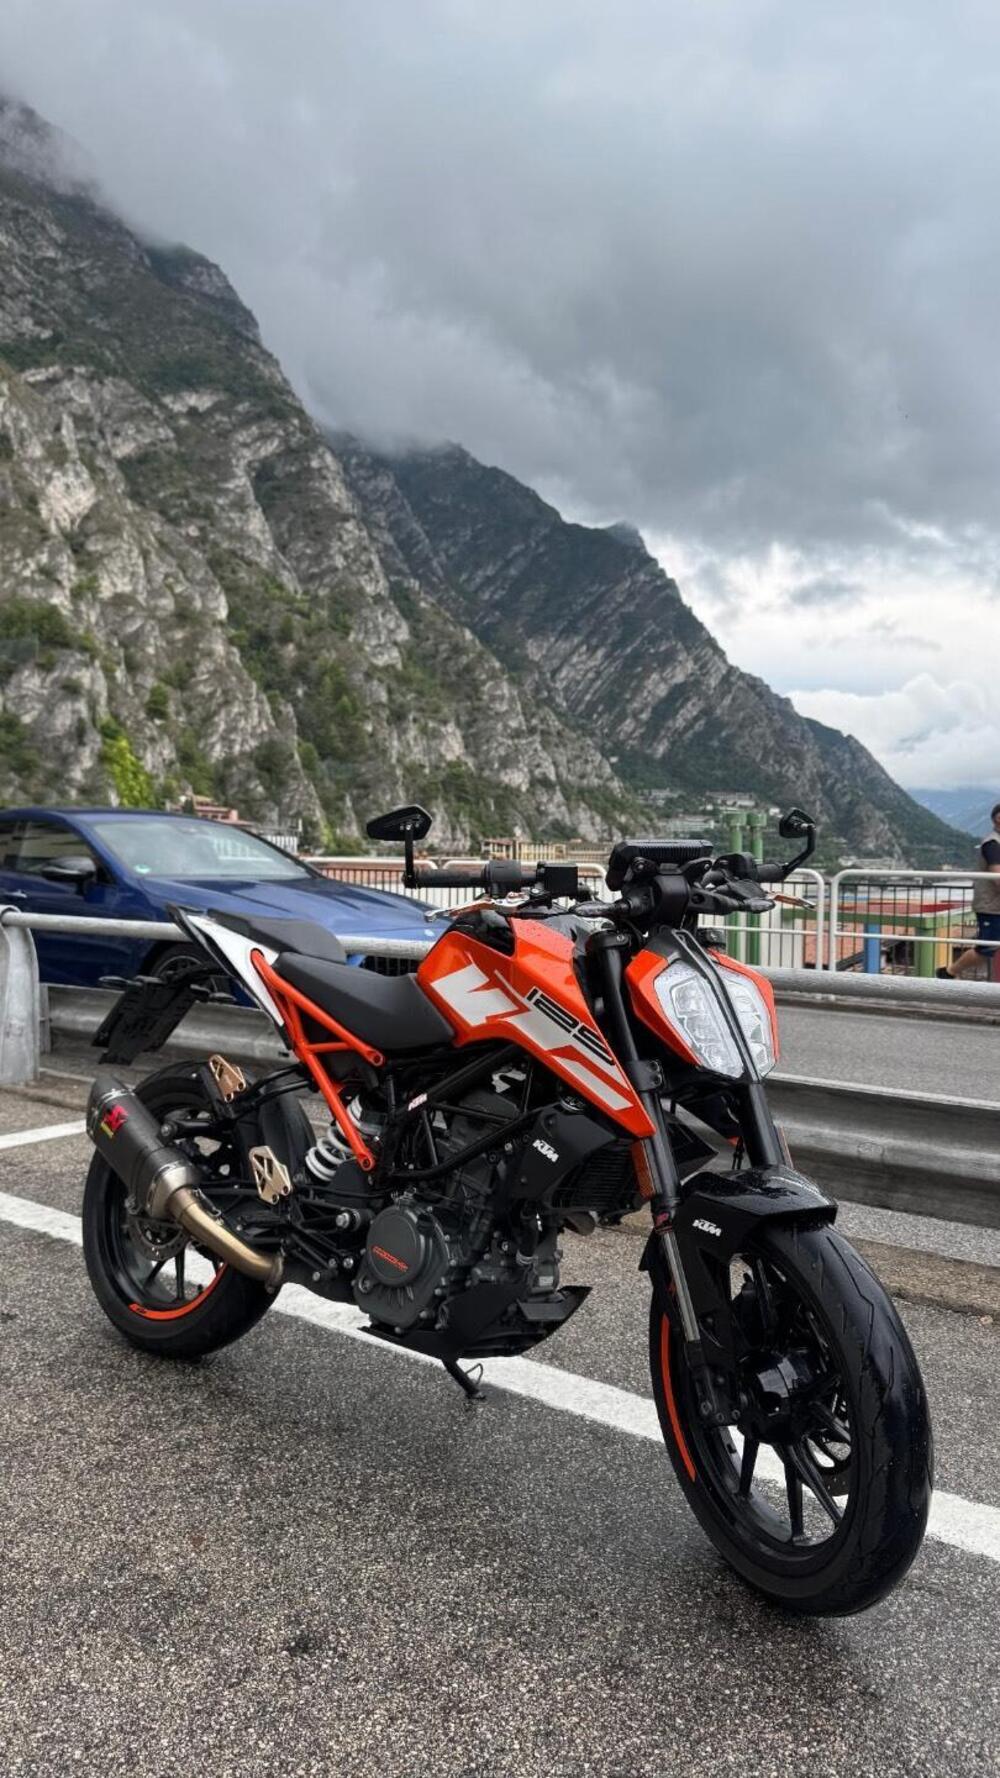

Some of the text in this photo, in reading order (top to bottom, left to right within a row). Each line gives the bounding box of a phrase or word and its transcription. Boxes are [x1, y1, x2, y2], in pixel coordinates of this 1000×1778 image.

[526, 988, 615, 1065] 125
[532, 1139, 559, 1162] KTM
[692, 1218, 721, 1236] KTM
